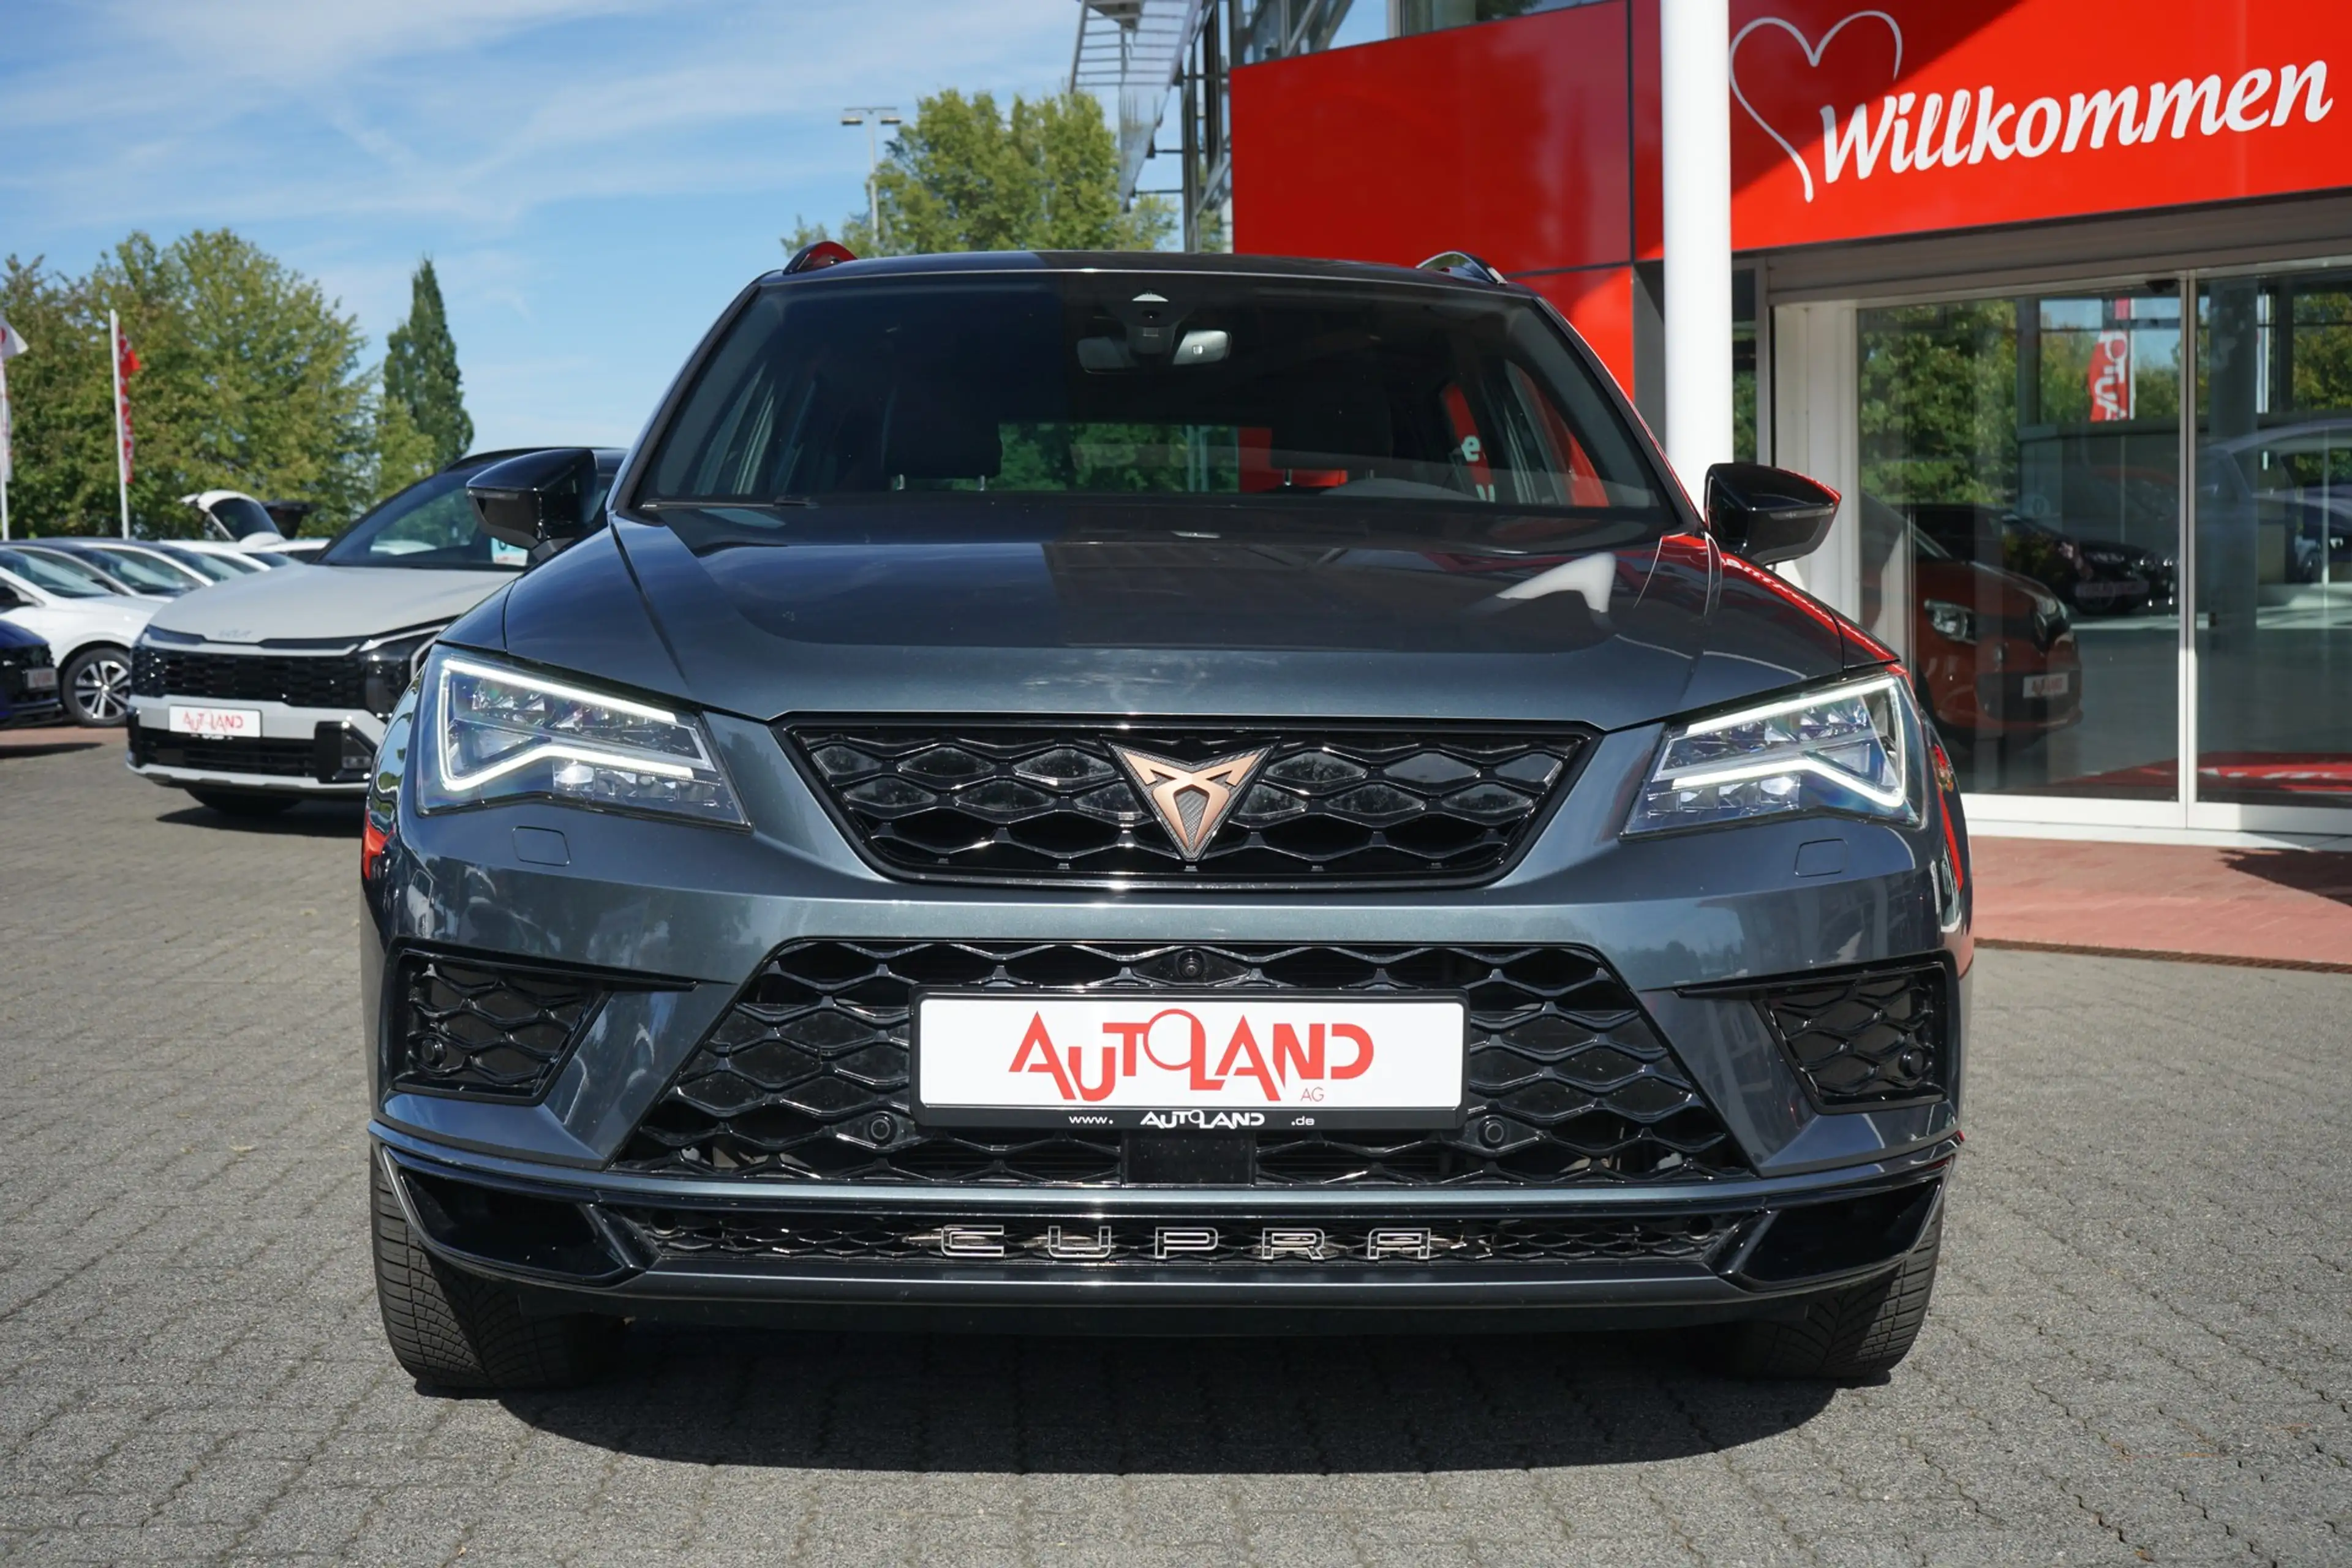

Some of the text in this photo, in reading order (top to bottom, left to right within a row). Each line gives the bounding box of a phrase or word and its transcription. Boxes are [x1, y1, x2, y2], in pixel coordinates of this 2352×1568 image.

[1819, 60, 2334, 184] Willkommen
[1009, 1008, 1374, 1102] AUTOLAND
[1300, 1087, 1325, 1102] AG
[1139, 1109, 1265, 1129] AUTOLAND
[1291, 1115, 1315, 1126] .de
[940, 1225, 1431, 1260] CUPRA
